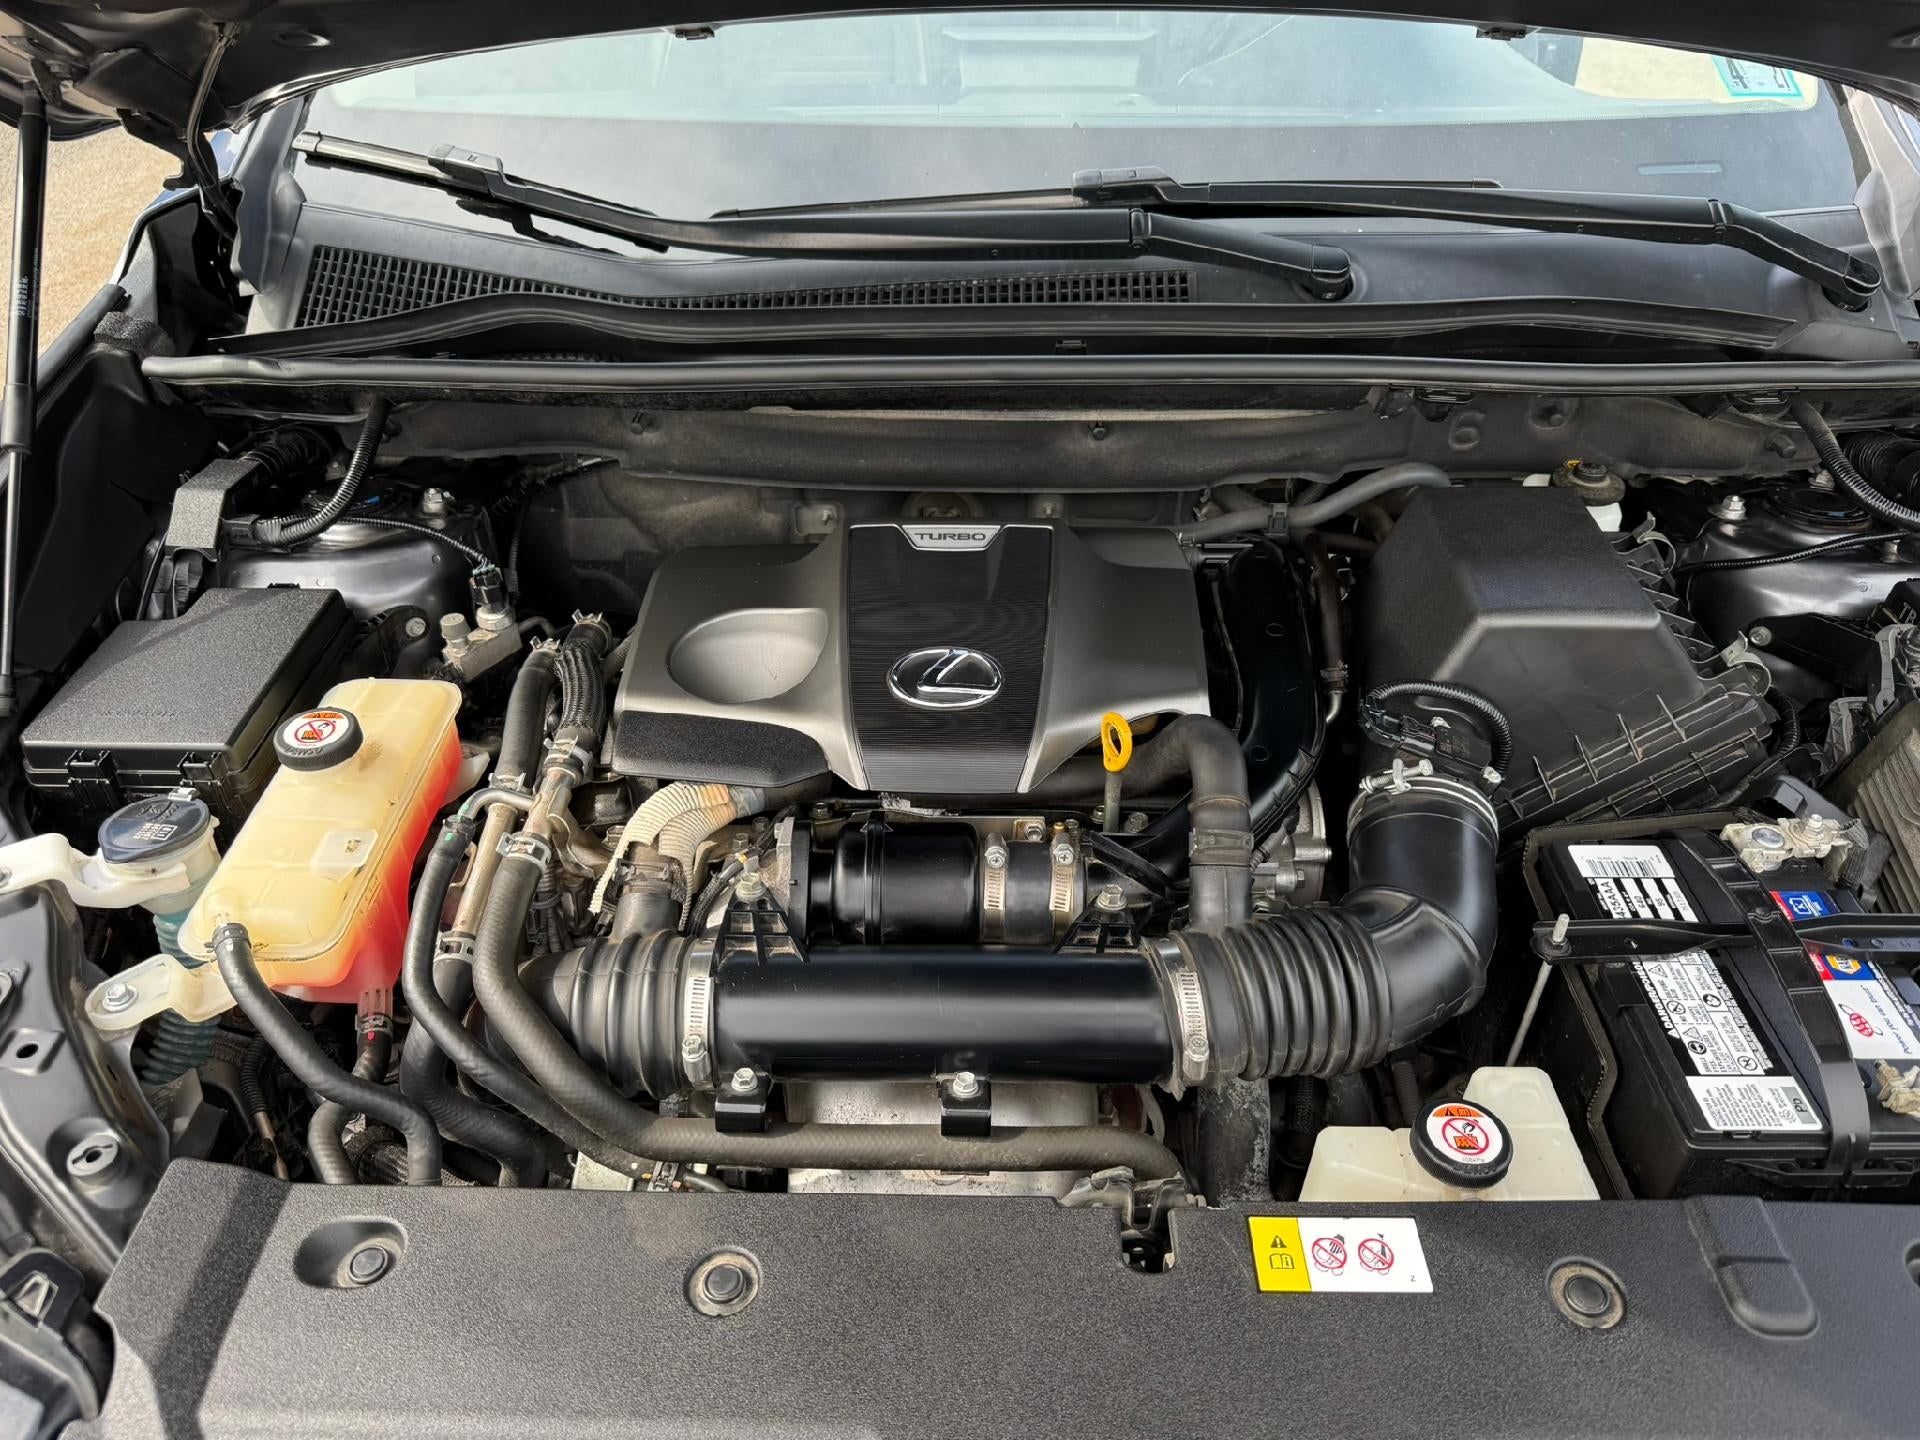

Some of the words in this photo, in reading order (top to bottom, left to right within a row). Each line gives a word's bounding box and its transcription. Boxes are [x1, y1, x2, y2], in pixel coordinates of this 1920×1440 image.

[914, 532, 986, 541] TURBO
[1600, 881, 1625, 918] 435AAA
[1792, 1098, 1808, 1113] Pb
